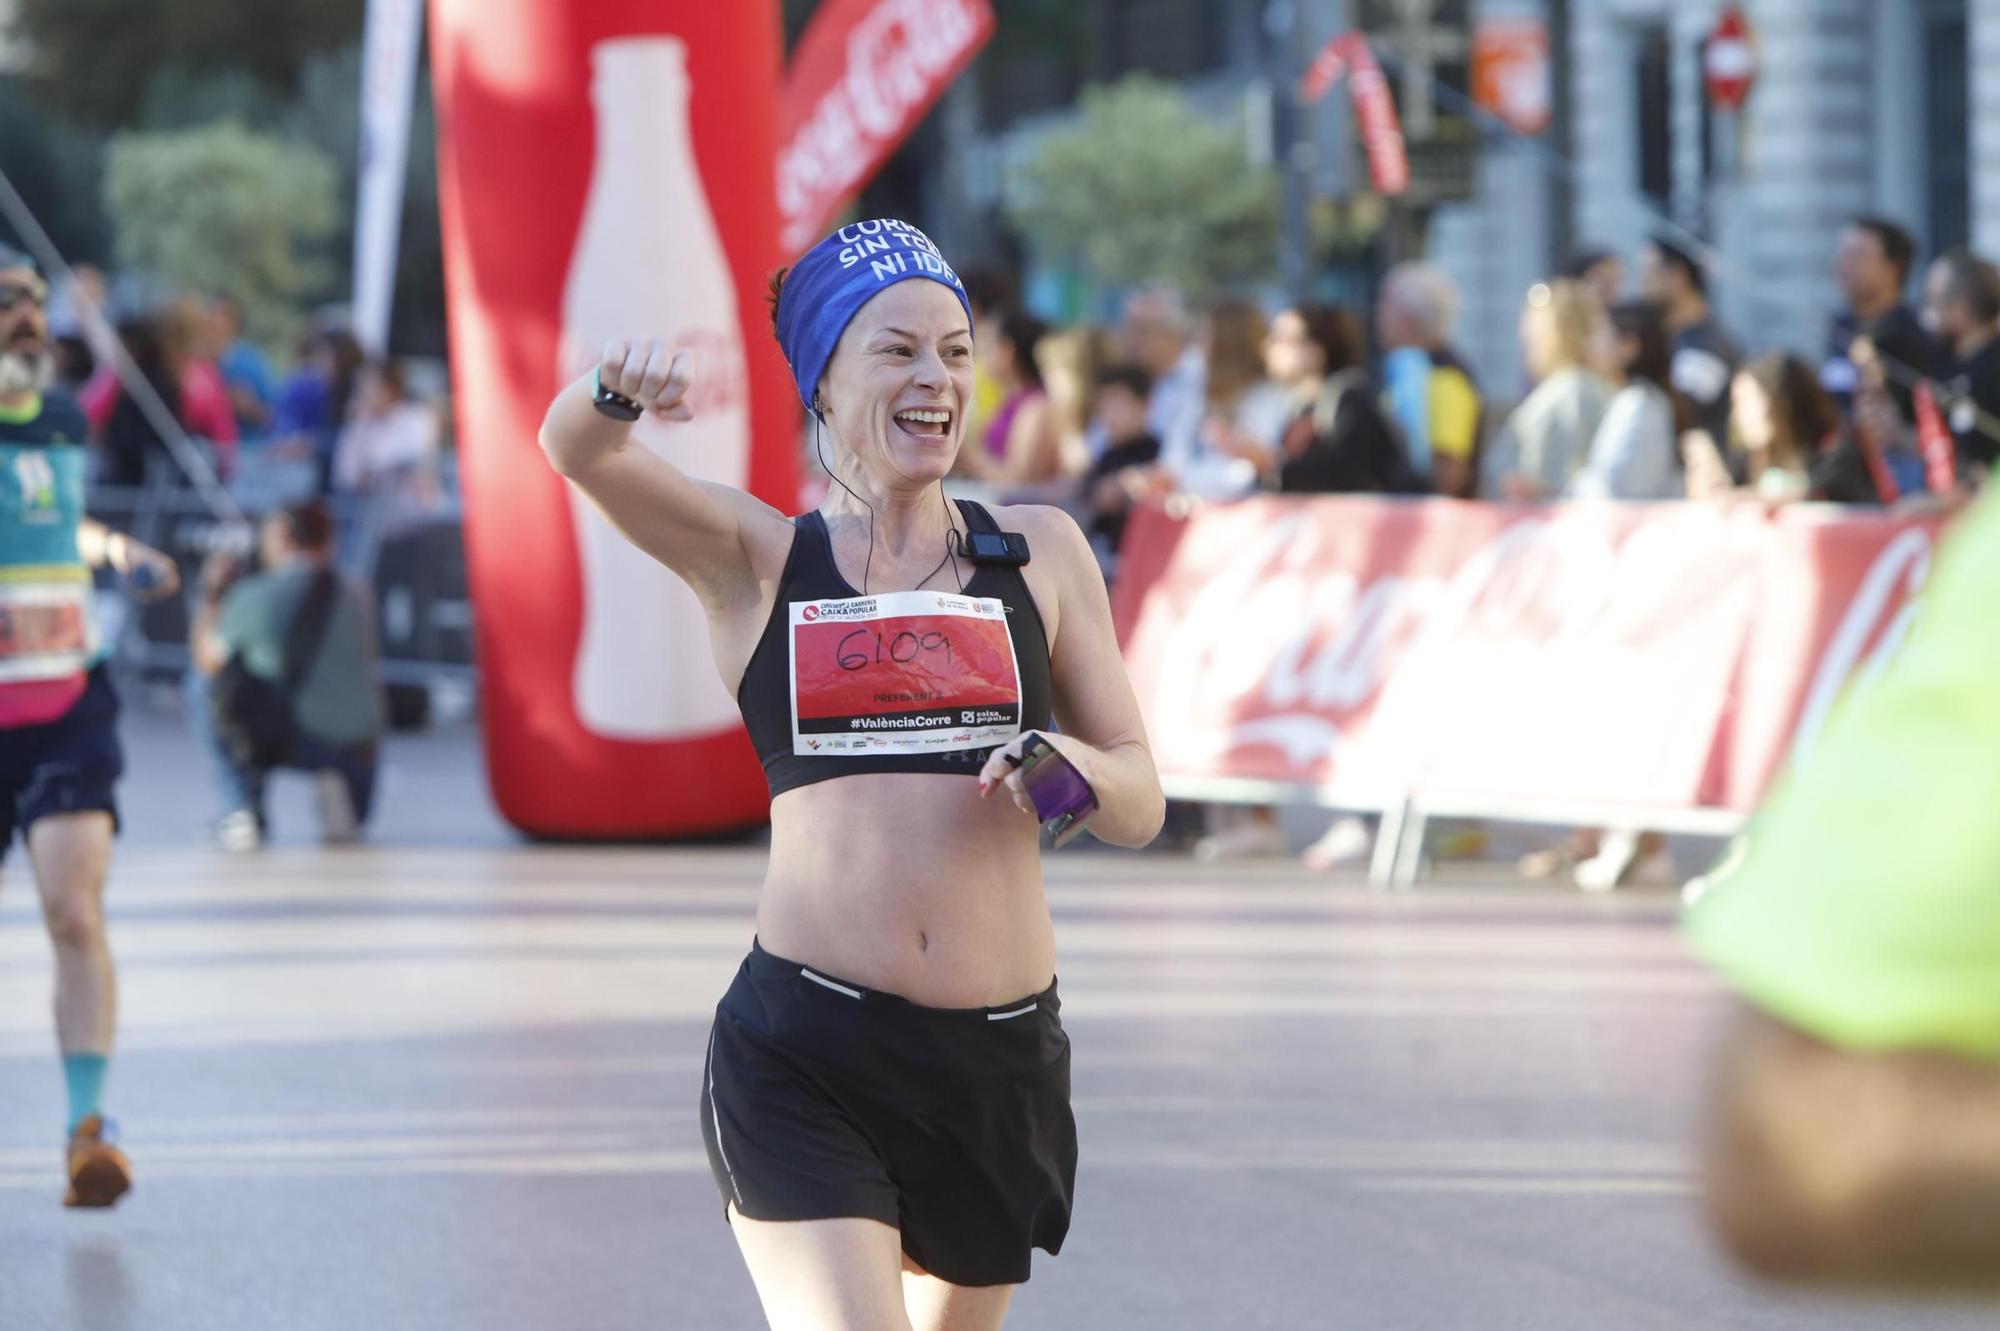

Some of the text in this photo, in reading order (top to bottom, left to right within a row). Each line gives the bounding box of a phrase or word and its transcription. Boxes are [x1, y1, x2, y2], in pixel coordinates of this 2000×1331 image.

[839, 235, 891, 269] SIN
[870, 252, 907, 281] NI
[820, 607, 849, 616] CAIXA
[849, 605, 877, 615] POPULAR
[836, 629, 951, 671] 6109
[976, 710, 999, 718] caixa
[976, 715, 1012, 724] popular
[851, 715, 952, 729] #ValènciaCorre
